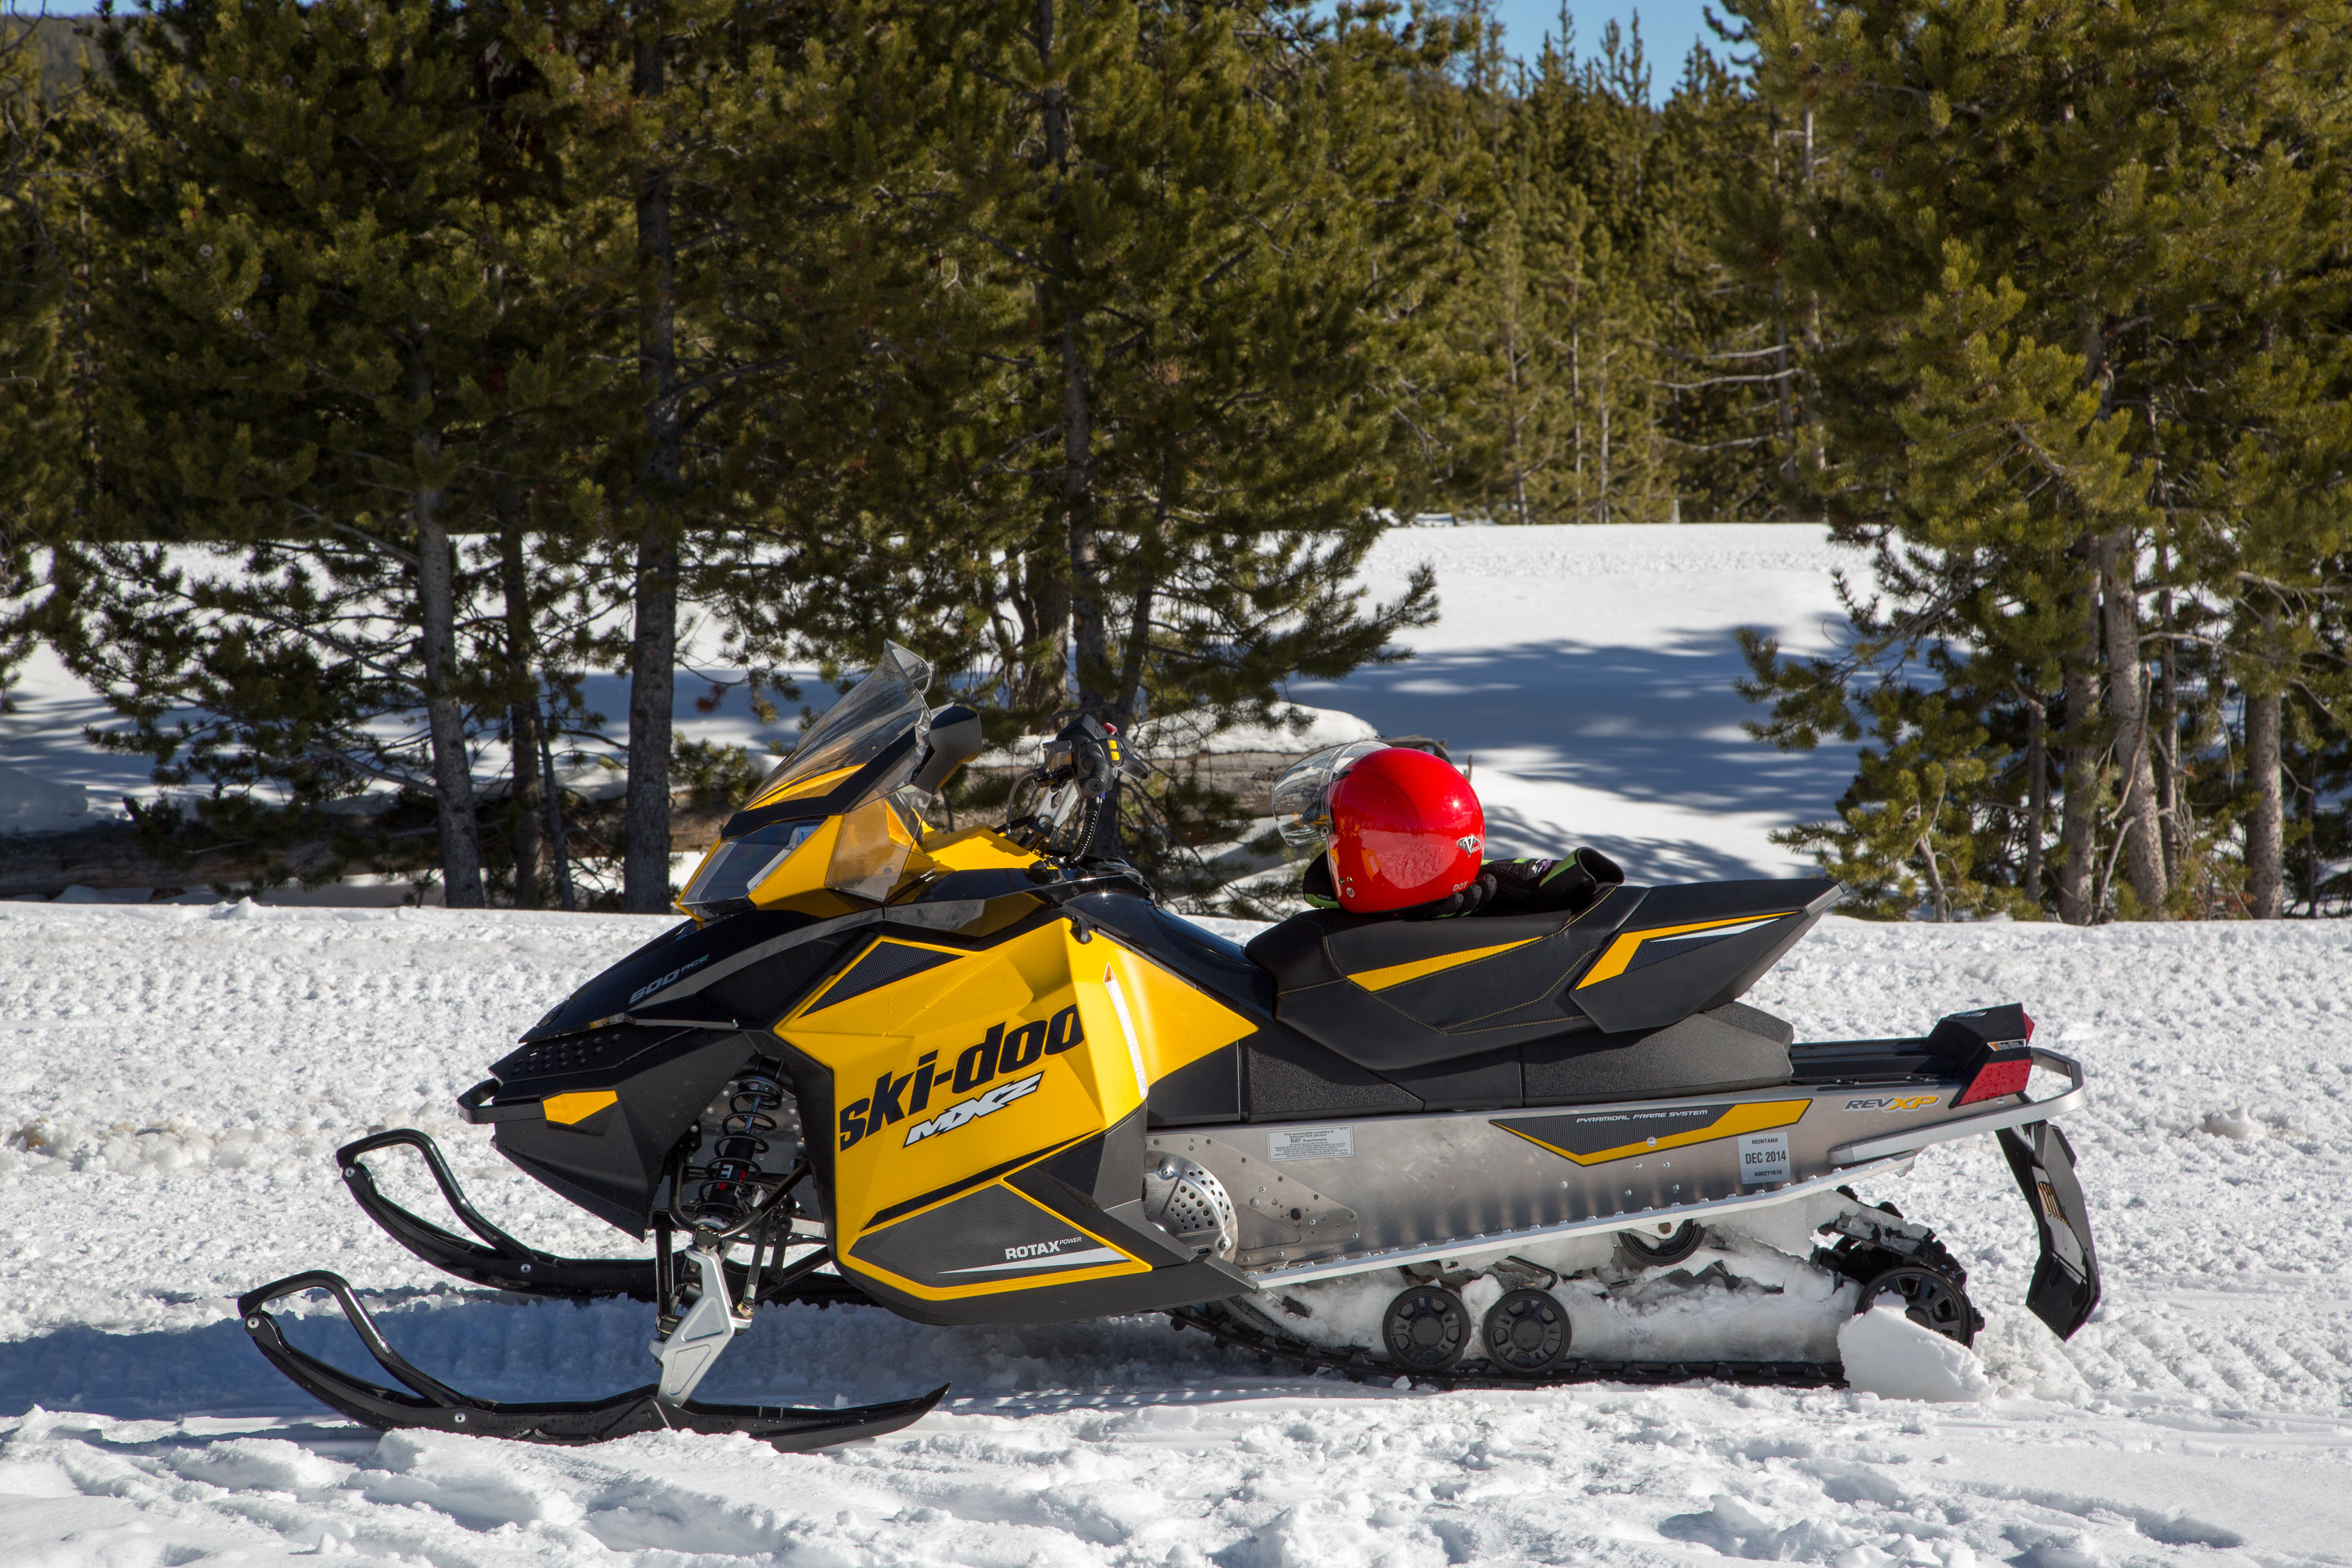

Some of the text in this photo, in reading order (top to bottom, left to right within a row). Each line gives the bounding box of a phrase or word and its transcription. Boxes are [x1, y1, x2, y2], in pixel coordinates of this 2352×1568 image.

[1452, 880, 1468, 892] DOT
[629, 969, 680, 1004] 600
[839, 1003, 1085, 1153] ski-doo
[1576, 1115, 1630, 1124] PYRAMIDAL
[1668, 1110, 1708, 1118] SYSTEM
[1745, 1150, 1787, 1165] DEC 2014
[1004, 1236, 1082, 1260] ROTAX POWER
